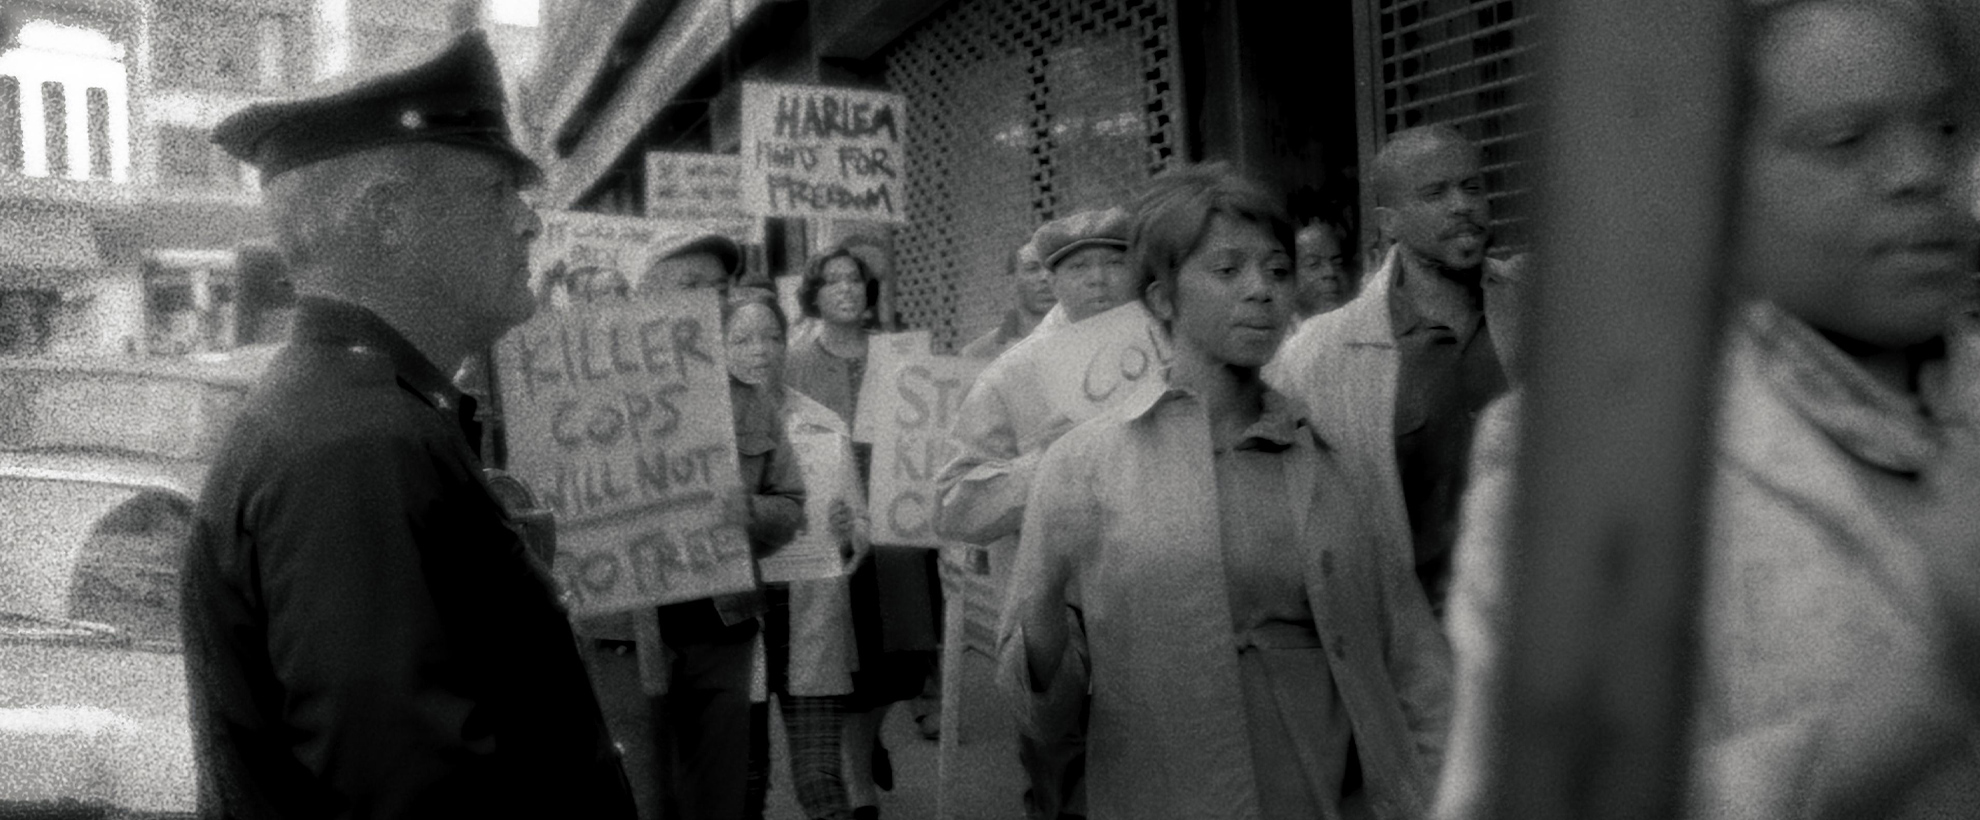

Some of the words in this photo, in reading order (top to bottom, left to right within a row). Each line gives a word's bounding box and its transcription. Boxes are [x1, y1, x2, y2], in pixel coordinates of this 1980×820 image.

[773, 96, 899, 143] HARLEM
[838, 146, 897, 178] FOR
[519, 317, 714, 403] KILLER
[552, 383, 688, 448] COPS
[895, 365, 966, 430] ST
[637, 444, 726, 497] NOT
[893, 435, 943, 481] KI
[628, 522, 746, 595] FREE
